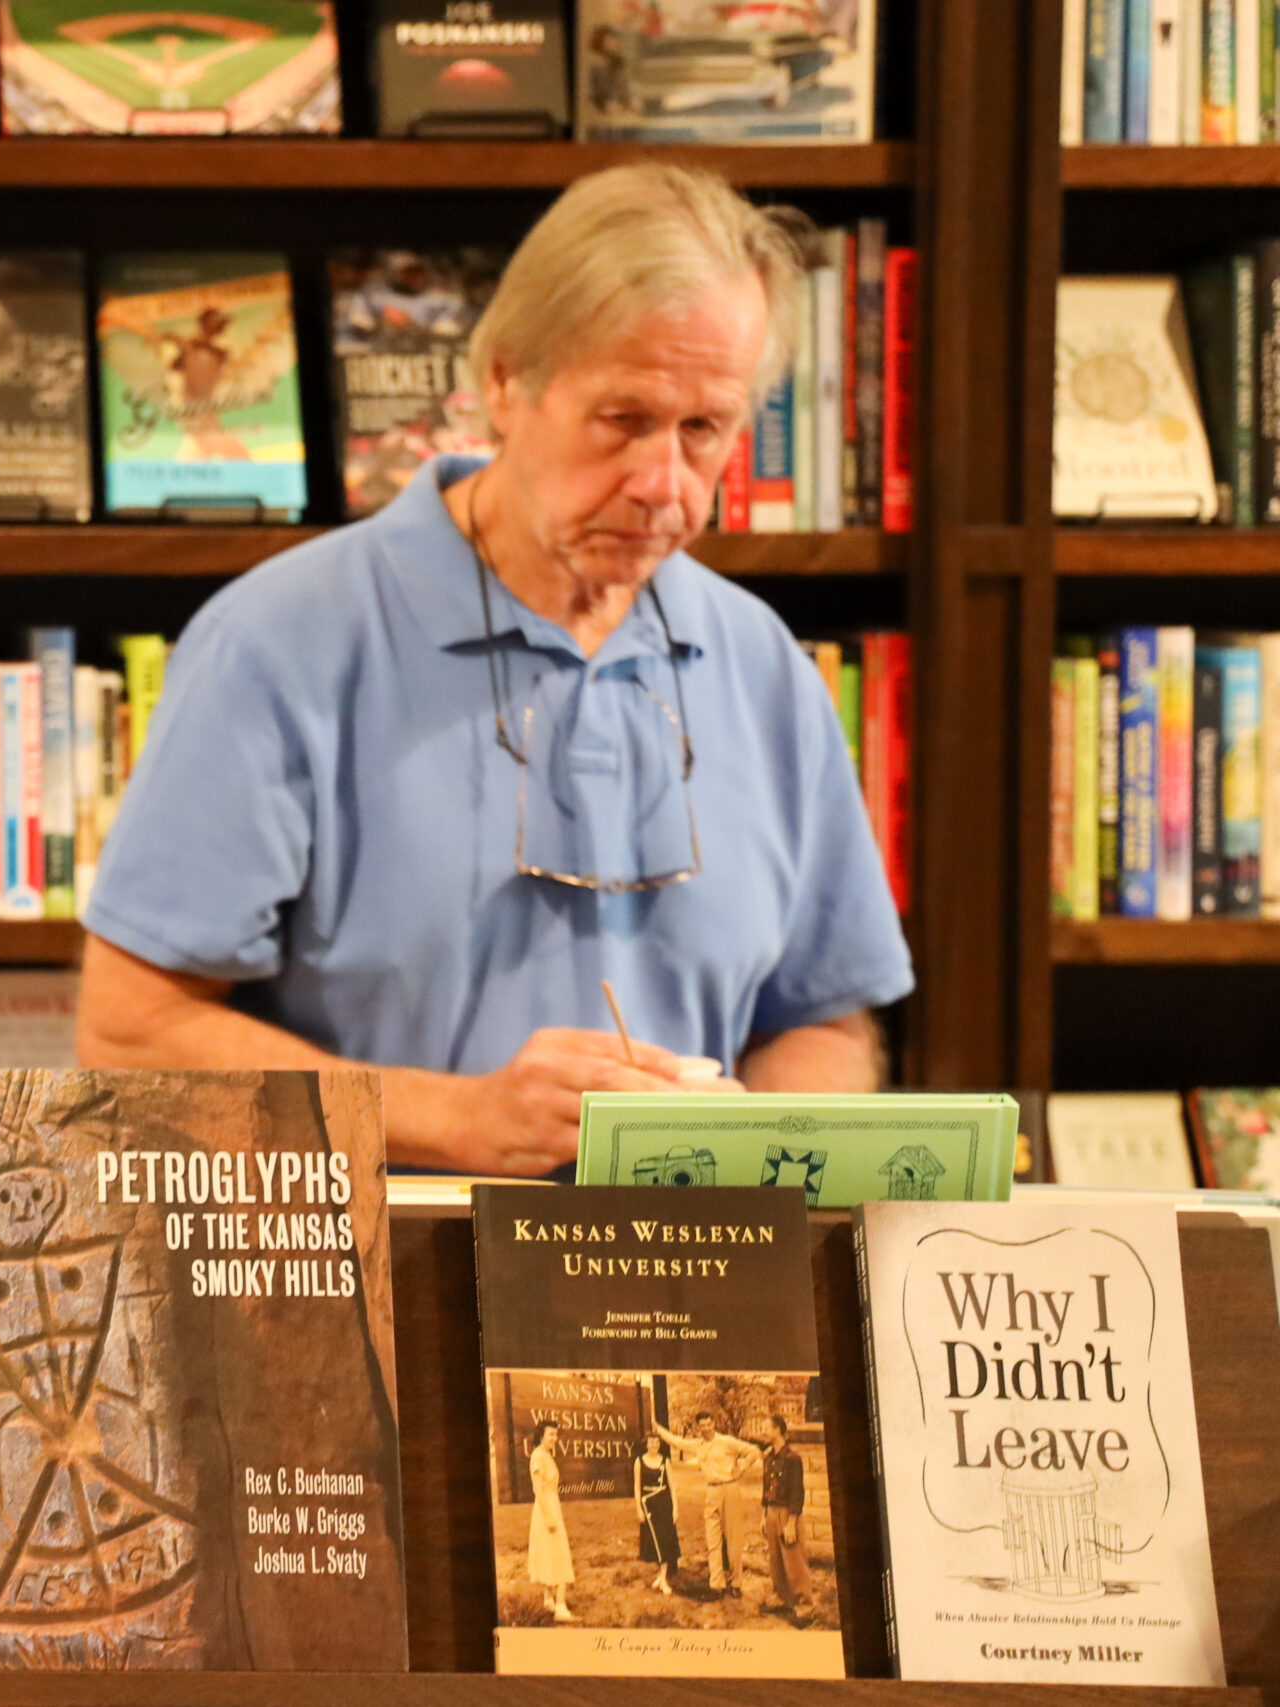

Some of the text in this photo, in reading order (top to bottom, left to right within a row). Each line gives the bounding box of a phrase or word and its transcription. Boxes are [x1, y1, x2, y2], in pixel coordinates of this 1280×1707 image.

[97, 1150, 352, 1205] PETROGLYPHS
[166, 1212, 354, 1251] OF THE KANSAS
[514, 1219, 774, 1243] KANSAS WESLEYAN
[191, 1259, 356, 1298] SMOKY HILLS
[563, 1254, 729, 1276] UNIVERSITY
[936, 1271, 1116, 1347] Why I
[940, 1340, 1126, 1403] Didn't
[542, 1381, 614, 1405] KANSAS
[530, 1408, 627, 1432] WESLEYAN
[948, 1409, 1130, 1472] Leave
[245, 1467, 364, 1495] Rex C. Buchanan
[558, 1480, 593, 1494] ounded
[248, 1506, 365, 1541] Burke W. Griggs
[254, 1545, 367, 1580] Joshua L. Svaty
[934, 1611, 964, 1623] When
[1013, 1614, 1087, 1627] Relationships
[1091, 1615, 1117, 1627] Hold
[1138, 1617, 1182, 1629] Hostage
[593, 1636, 612, 1652] The
[670, 1637, 711, 1656] History
[717, 1638, 754, 1654] Series
[980, 1643, 1144, 1664] Courtney Miller
